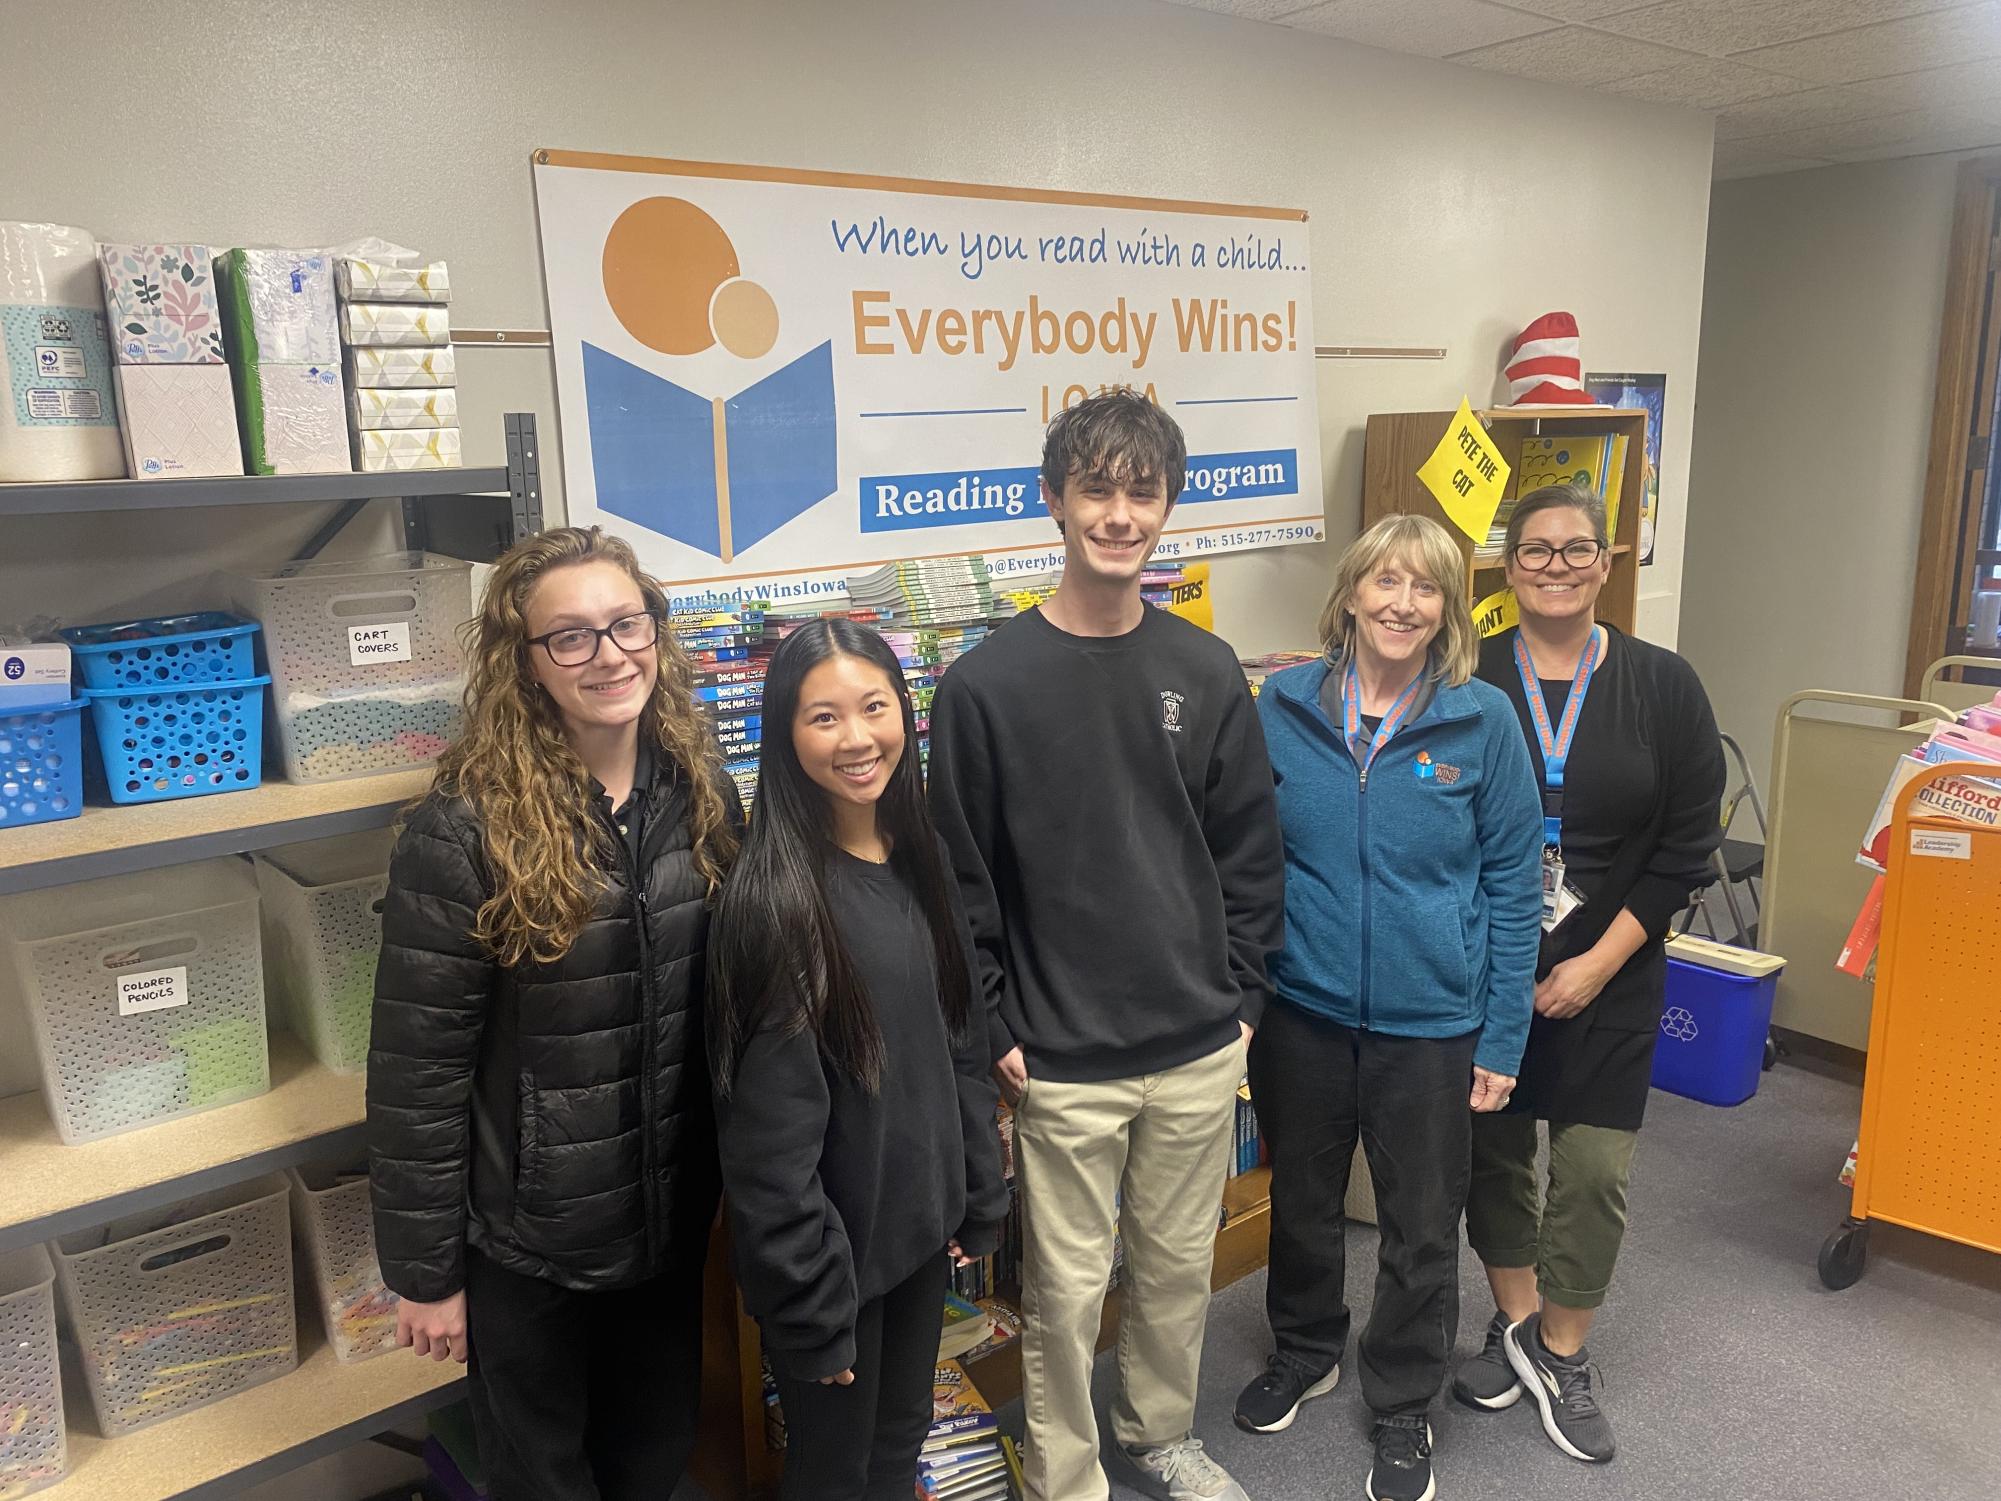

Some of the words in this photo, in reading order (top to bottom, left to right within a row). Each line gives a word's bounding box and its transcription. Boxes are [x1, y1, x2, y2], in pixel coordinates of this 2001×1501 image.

[832, 216, 949, 257] When
[961, 231, 1029, 280] you
[1039, 227, 1108, 264] read
[1117, 227, 1181, 268] with
[1191, 242, 1206, 268] a
[1216, 233, 1307, 272] child...
[852, 290, 1158, 372] Everybody
[1171, 297, 1297, 353] Wins!
[1457, 424, 1483, 462] PETE
[1475, 451, 1500, 484] THE
[875, 475, 1027, 517] Reading
[1183, 462, 1286, 497] rogram
[1452, 468, 1475, 498] CAT
[1195, 534, 1217, 550] Ph:
[1221, 525, 1315, 547] 515-277-7590
[1168, 579, 1204, 606] TTERS
[354, 630, 389, 641] CART
[358, 642, 399, 653] COVERS
[7, 665, 22, 675] 52
[716, 673, 731, 683] DOG
[732, 671, 746, 682] MAN
[716, 686, 731, 698] DOG
[732, 684, 746, 695] MAN
[716, 699, 731, 711] DOG
[732, 698, 746, 709] MAN
[717, 720, 732, 731] DOG
[732, 718, 746, 730] MAN
[717, 732, 732, 743] DOG
[732, 730, 746, 741] MAN
[725, 744, 740, 755] DOG
[740, 742, 754, 753] MAN
[1927, 776, 2001, 813] lifford
[1914, 787, 1998, 825] OLLECTION
[122, 976, 174, 992] COLORED
[127, 987, 175, 1003] PENCILS
